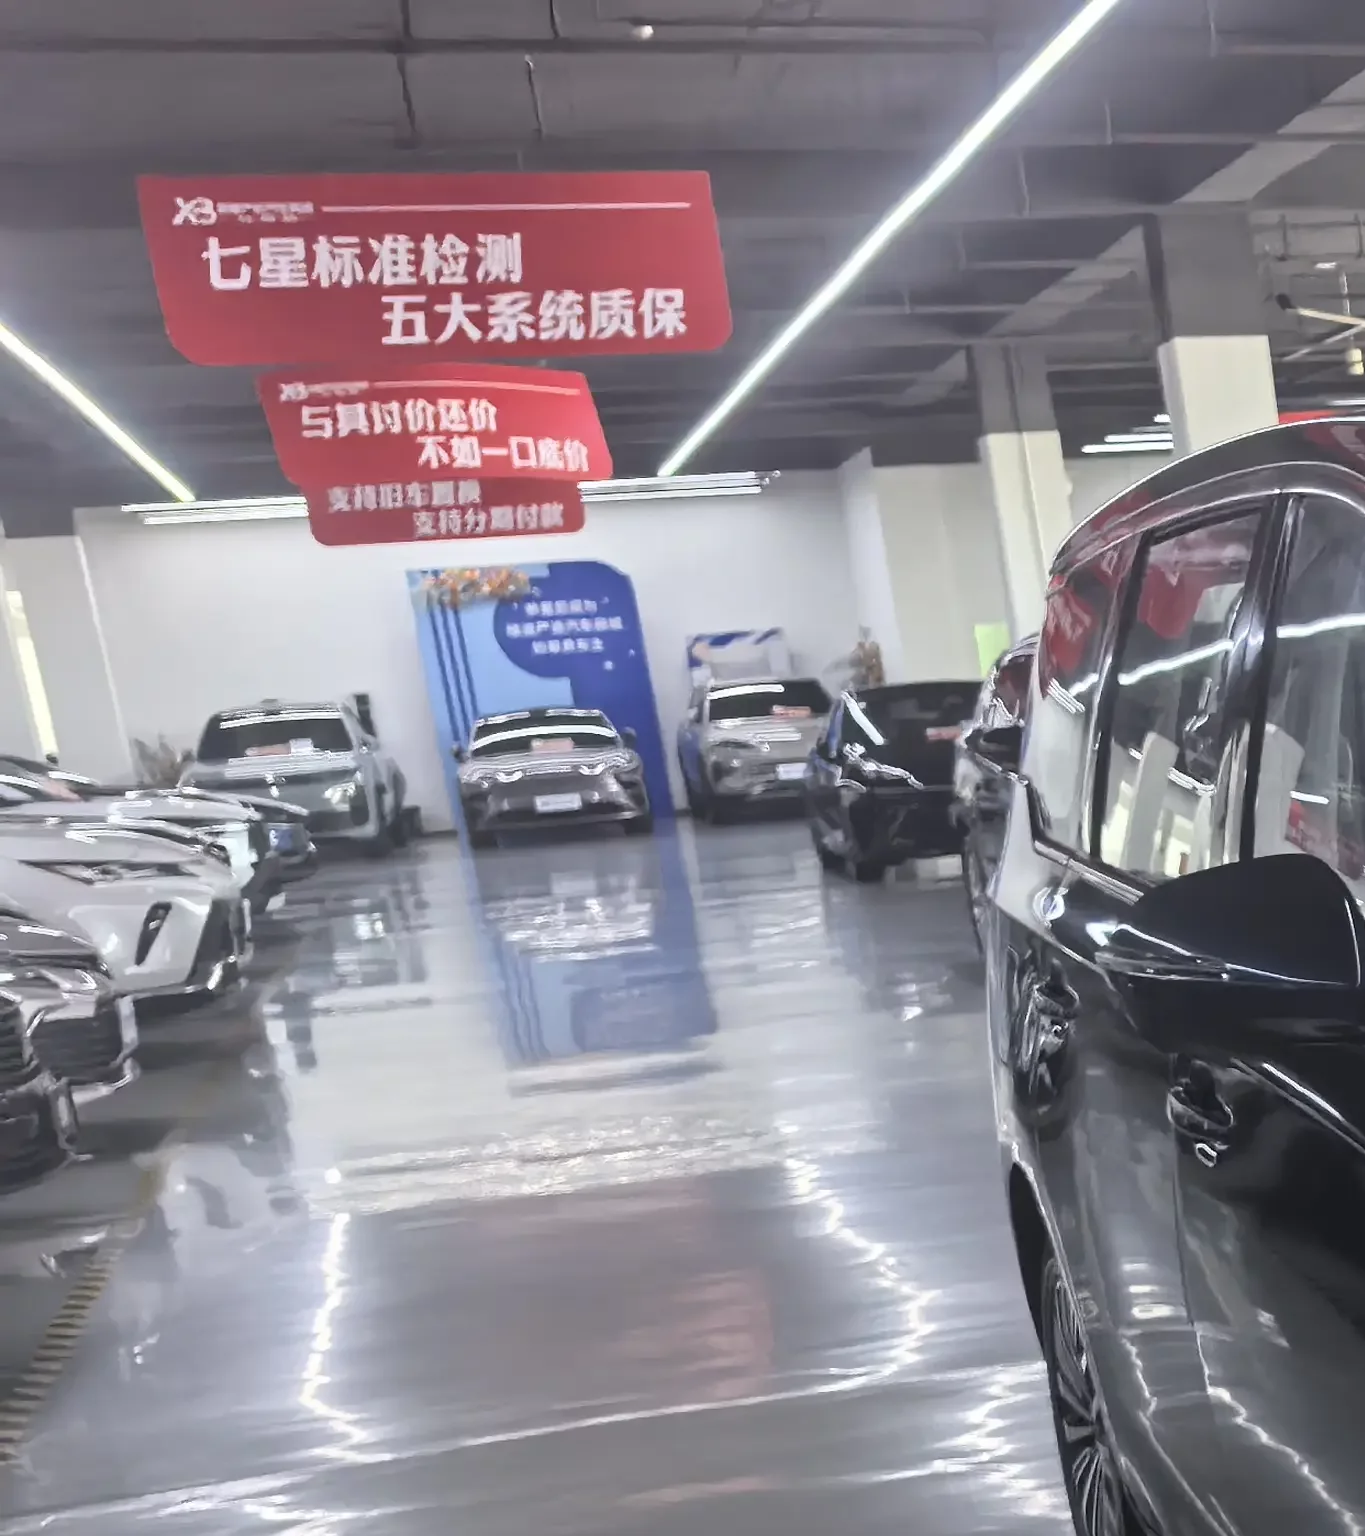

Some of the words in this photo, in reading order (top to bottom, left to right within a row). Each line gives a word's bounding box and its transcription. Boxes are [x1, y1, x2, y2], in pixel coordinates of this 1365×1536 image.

[201, 232, 523, 290] 七星标准检测
[381, 288, 687, 346] 五大系统质保
[301, 398, 497, 438] 与其讨价还价
[416, 435, 589, 471] 不如一口底价
